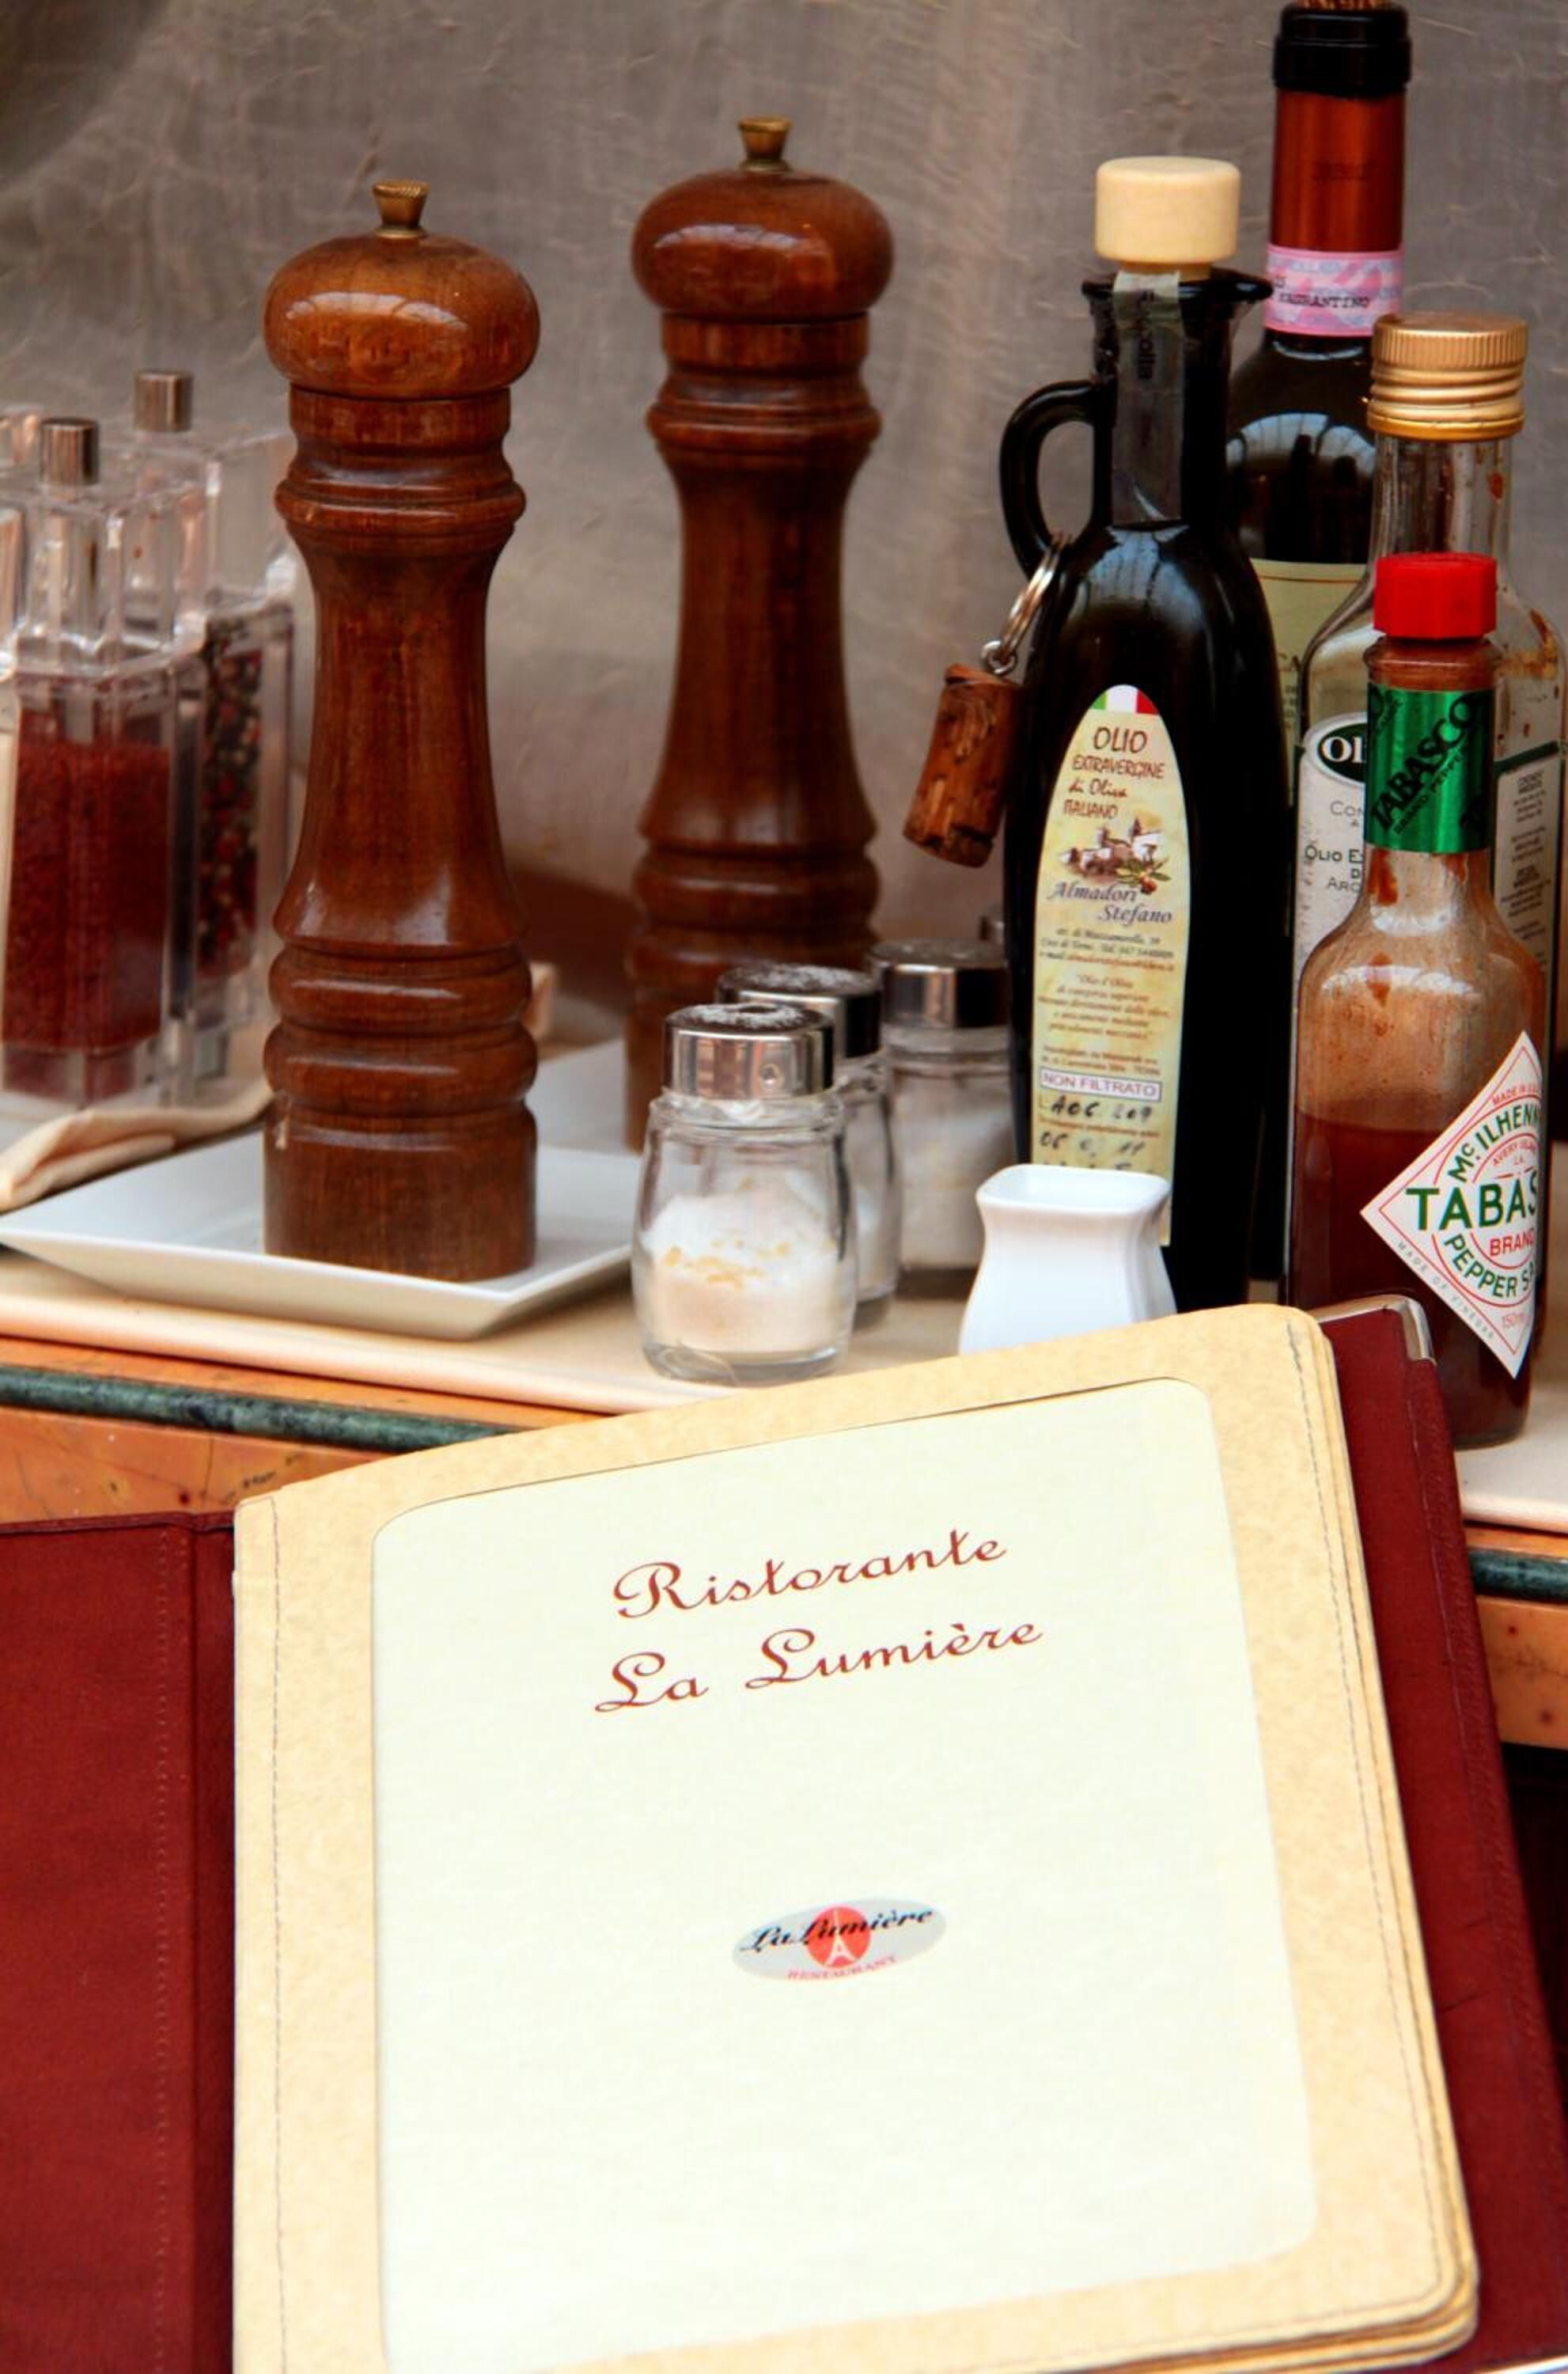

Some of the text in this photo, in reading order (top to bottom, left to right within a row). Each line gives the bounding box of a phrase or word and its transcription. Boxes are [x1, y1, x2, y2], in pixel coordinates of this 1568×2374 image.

[1093, 726, 1147, 753] OLIO
[1072, 753, 1166, 779] EXTRAVERGINE
[1063, 798, 1119, 819] ITALIANO
[1047, 881, 1138, 902] Almadori
[1097, 903, 1173, 927] Stefano
[1043, 1071, 1156, 1097] NON FILTRATO
[1489, 1227, 1536, 1257] BRAND
[1443, 1234, 1518, 1299] PEPPER
[612, 1529, 1007, 1618] Ristorante
[594, 1623, 1043, 1712] La Lumière
